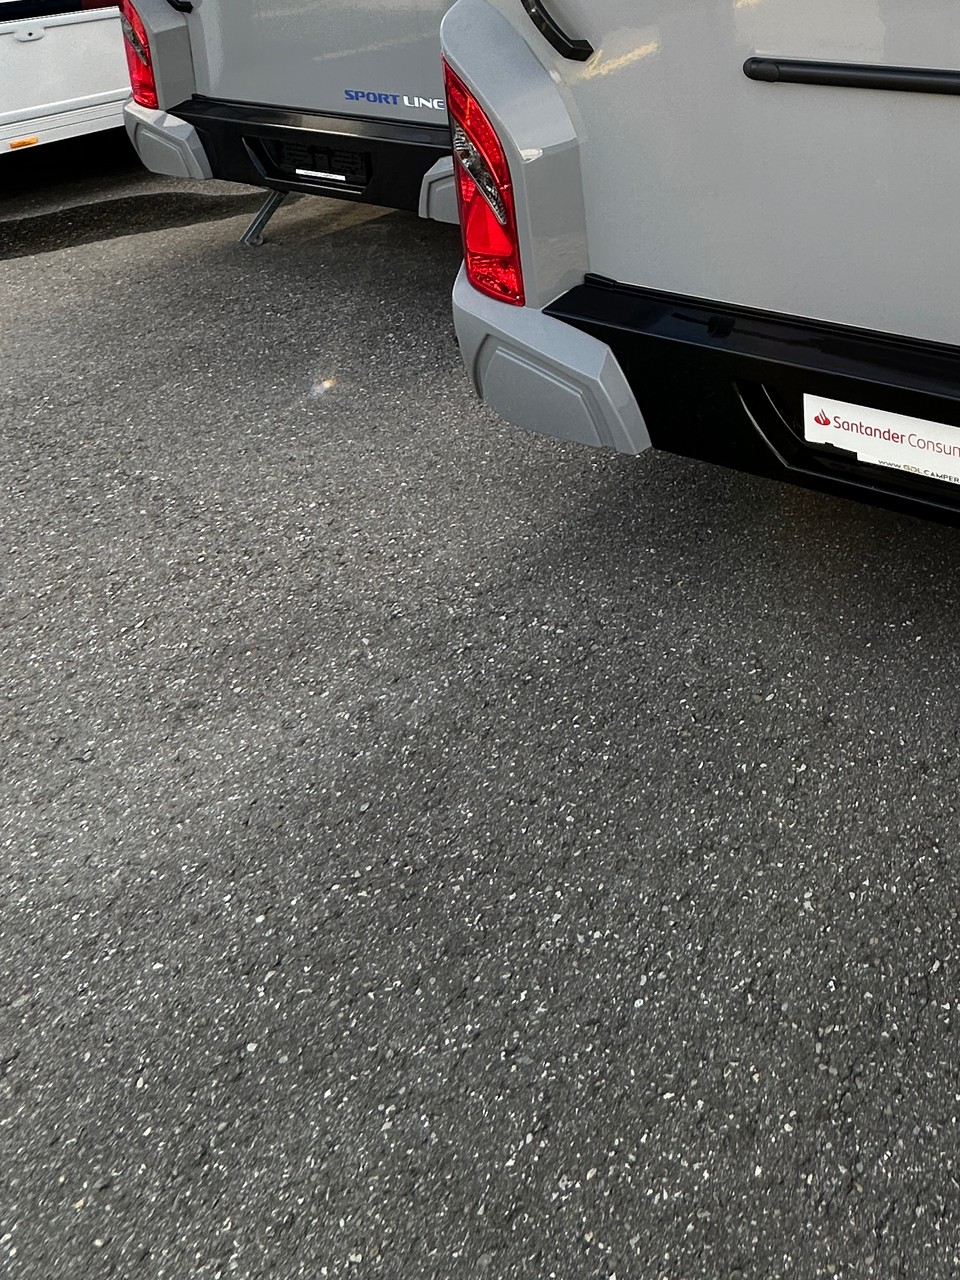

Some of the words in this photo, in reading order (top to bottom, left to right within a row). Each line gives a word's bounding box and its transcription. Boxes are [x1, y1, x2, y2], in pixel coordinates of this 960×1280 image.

[344, 89, 400, 105] SPORT
[403, 96, 445, 110] LINE
[833, 416, 906, 445] Santander
